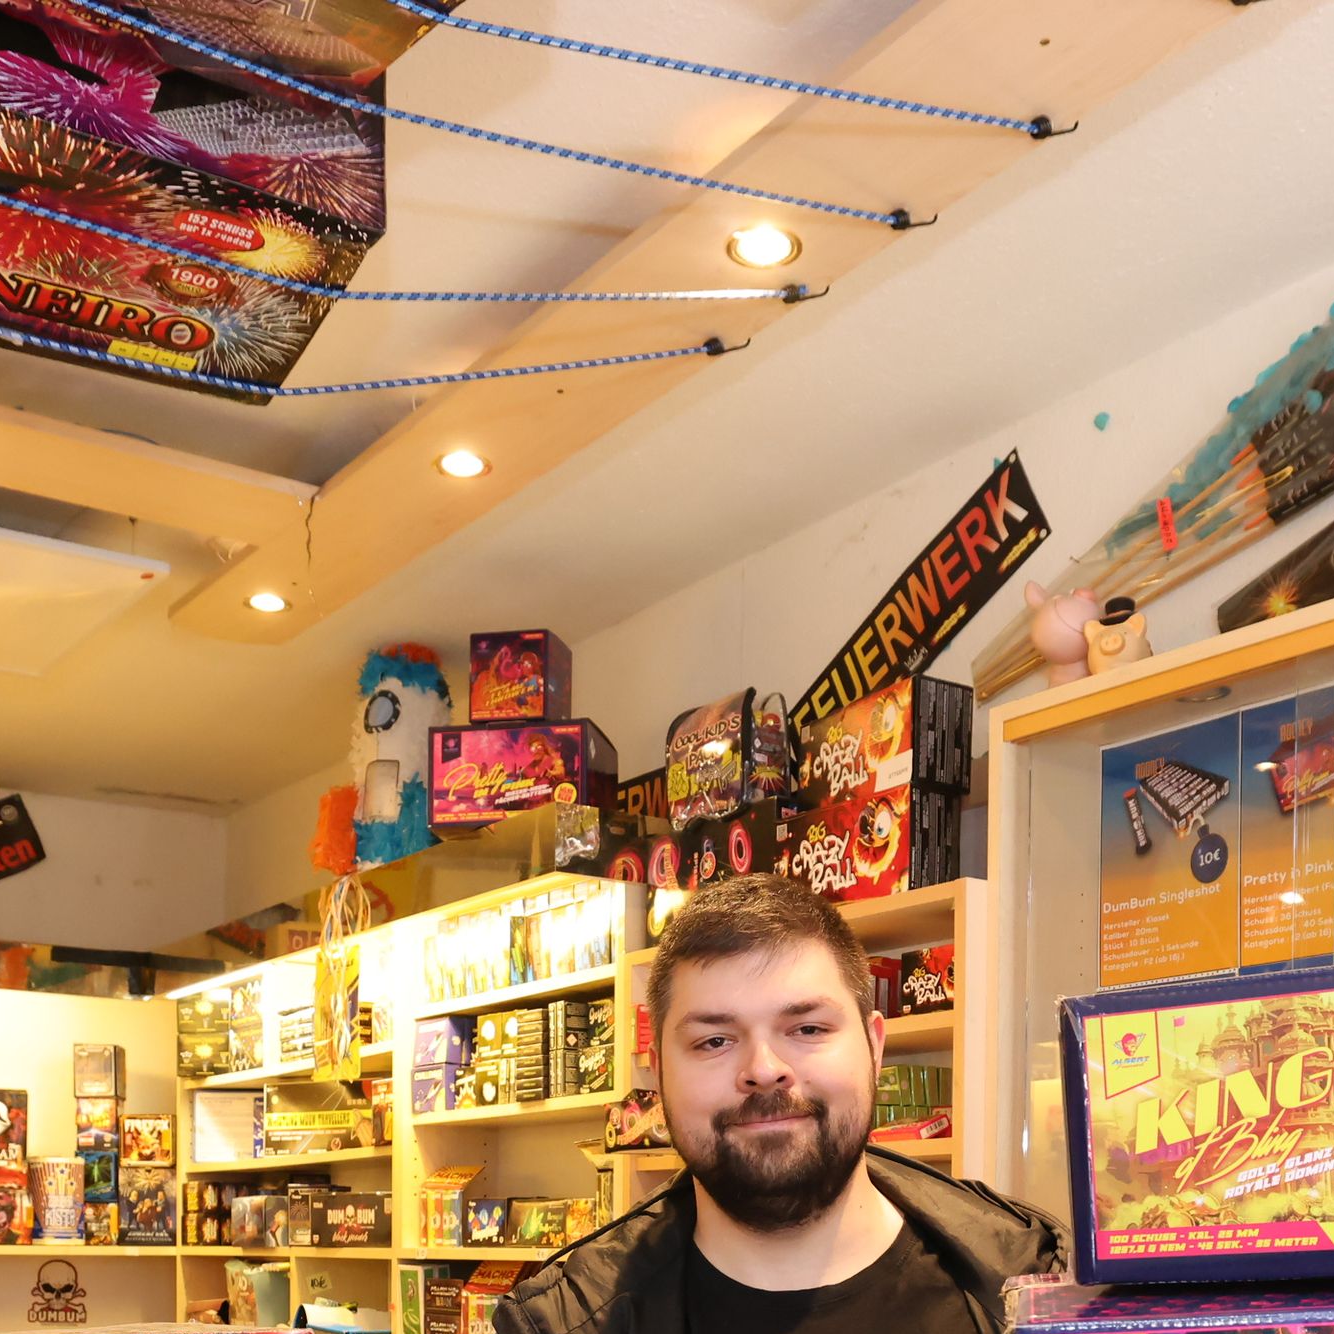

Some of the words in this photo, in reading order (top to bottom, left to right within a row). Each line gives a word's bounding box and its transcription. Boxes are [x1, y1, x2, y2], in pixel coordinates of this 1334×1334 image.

[210, 216, 256, 240] SCHUSS
[169, 267, 219, 290] 1900
[793, 468, 1030, 737] FEUERWERK
[674, 730, 705, 751] COOL
[813, 728, 863, 777] CRAZY
[443, 761, 507, 802] Pretty
[828, 756, 871, 797] BALL
[792, 831, 850, 876] CRAZY
[1199, 848, 1223, 867] 10€
[810, 857, 858, 895] BALL
[1243, 871, 1287, 891] Pretty
[1305, 861, 1334, 876] Pink
[1102, 895, 1156, 915] DumBum
[1158, 882, 1222, 906] Singleshot
[903, 972, 942, 993] CRAZY
[914, 985, 946, 1005] BALL
[1135, 1046, 1334, 1155] KING
[1195, 1108, 1304, 1187] Bling
[1285, 1147, 1333, 1171] GLANZ
[433, 1171, 474, 1183] MACHO
[326, 1208, 346, 1225] DUM
[356, 1208, 376, 1224] BUM
[1132, 1232, 1177, 1243] SCHUSS
[479, 1269, 518, 1281] MACHO
[28, 1308, 87, 1323] DUMBUM
